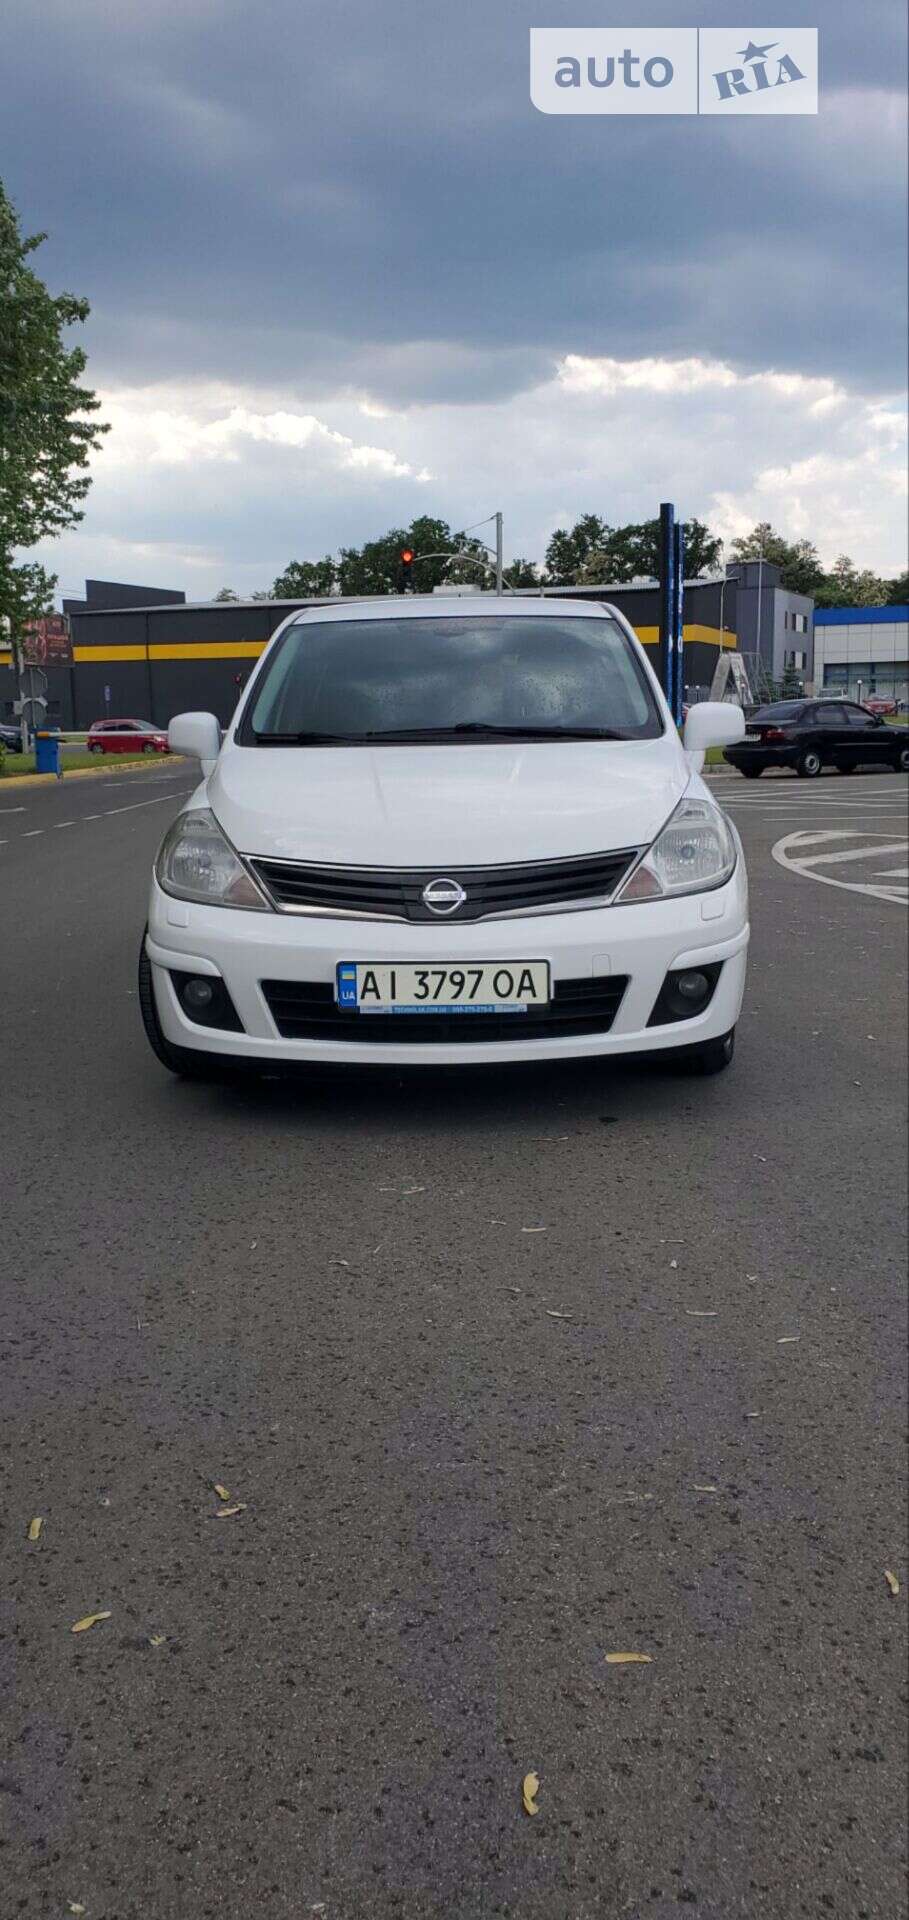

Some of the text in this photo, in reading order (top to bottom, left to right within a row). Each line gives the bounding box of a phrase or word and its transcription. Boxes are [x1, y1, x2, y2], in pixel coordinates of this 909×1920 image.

[360, 969, 537, 1000] AI 3797 OA
[342, 990, 356, 1000] UA
